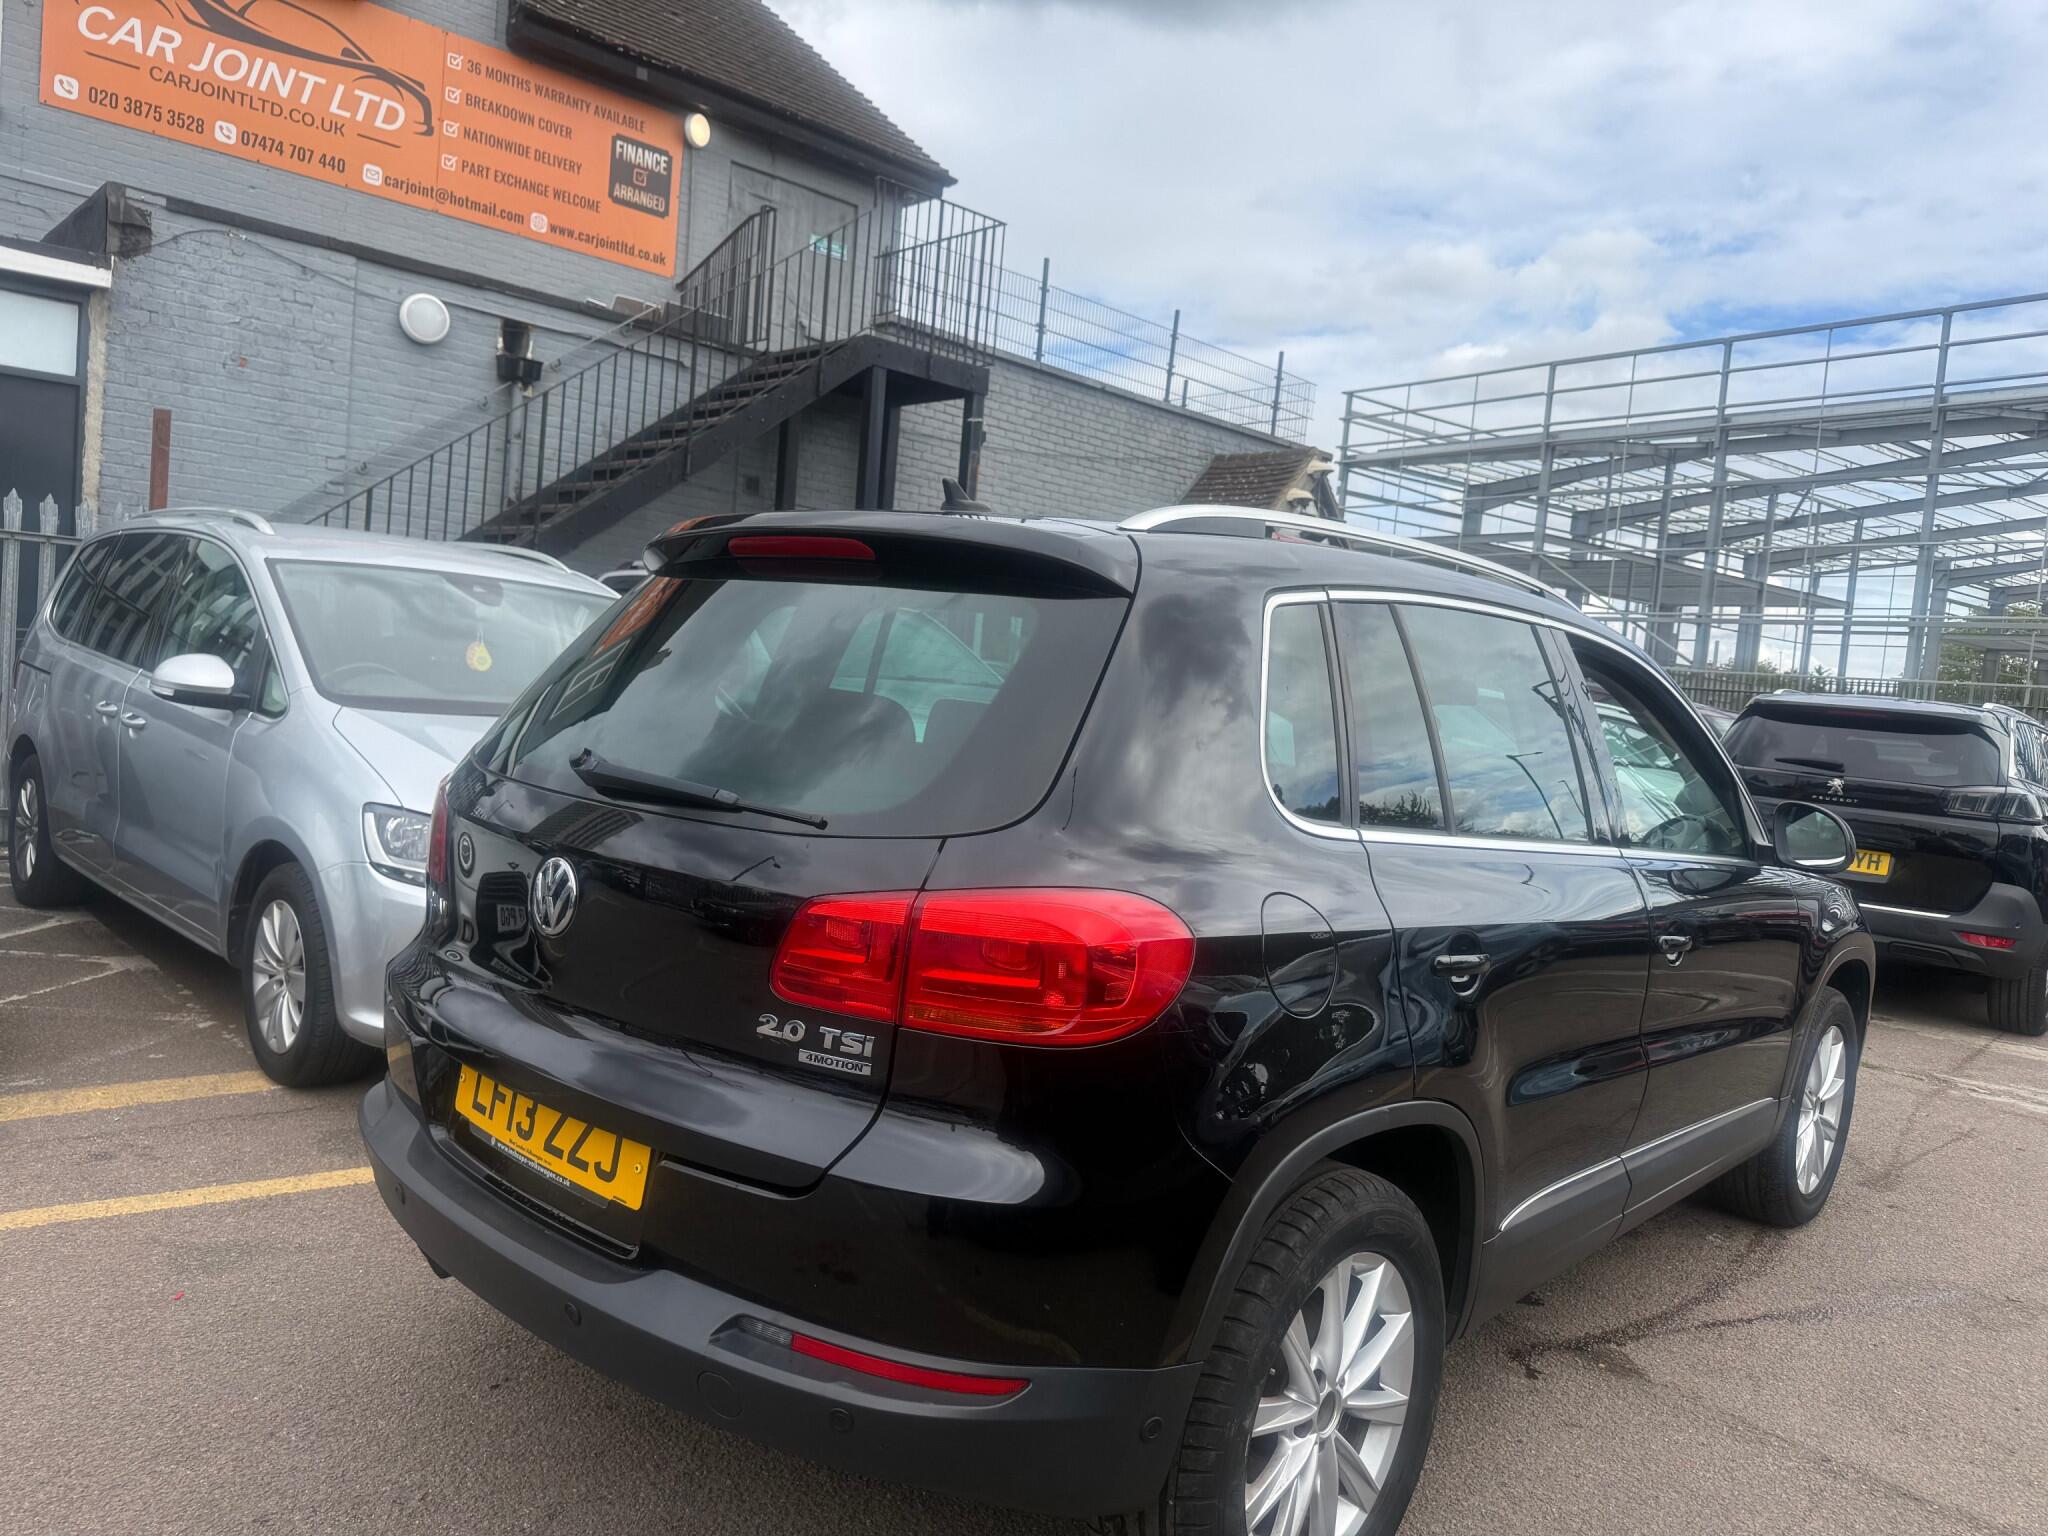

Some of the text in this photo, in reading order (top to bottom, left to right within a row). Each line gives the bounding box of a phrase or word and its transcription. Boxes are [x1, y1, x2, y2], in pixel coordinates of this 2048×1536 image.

[77, 5, 406, 131] CAR JOINT LTD
[88, 86, 205, 135] 020 3875 3528
[148, 66, 345, 137] CARJOINTLTD.CO.UK
[465, 92, 573, 140] BREAKDOWN COVER
[467, 59, 646, 134] 36 MONTHS WARRANTY AVAILABLE
[241, 130, 346, 174] 07474 707 440
[463, 127, 582, 175] NATIONWIDE DELIVERY
[615, 139, 668, 175] FINANCE
[384, 174, 525, 225] carjoint@hotmail.com
[461, 159, 601, 213] PART EXCHANGE WELCOME
[613, 182, 665, 213] ARRANGED
[550, 223, 666, 266] www.carjointltd.co.uk
[805, 1053, 865, 1073] 4MOTION
[819, 1026, 876, 1057] TSI
